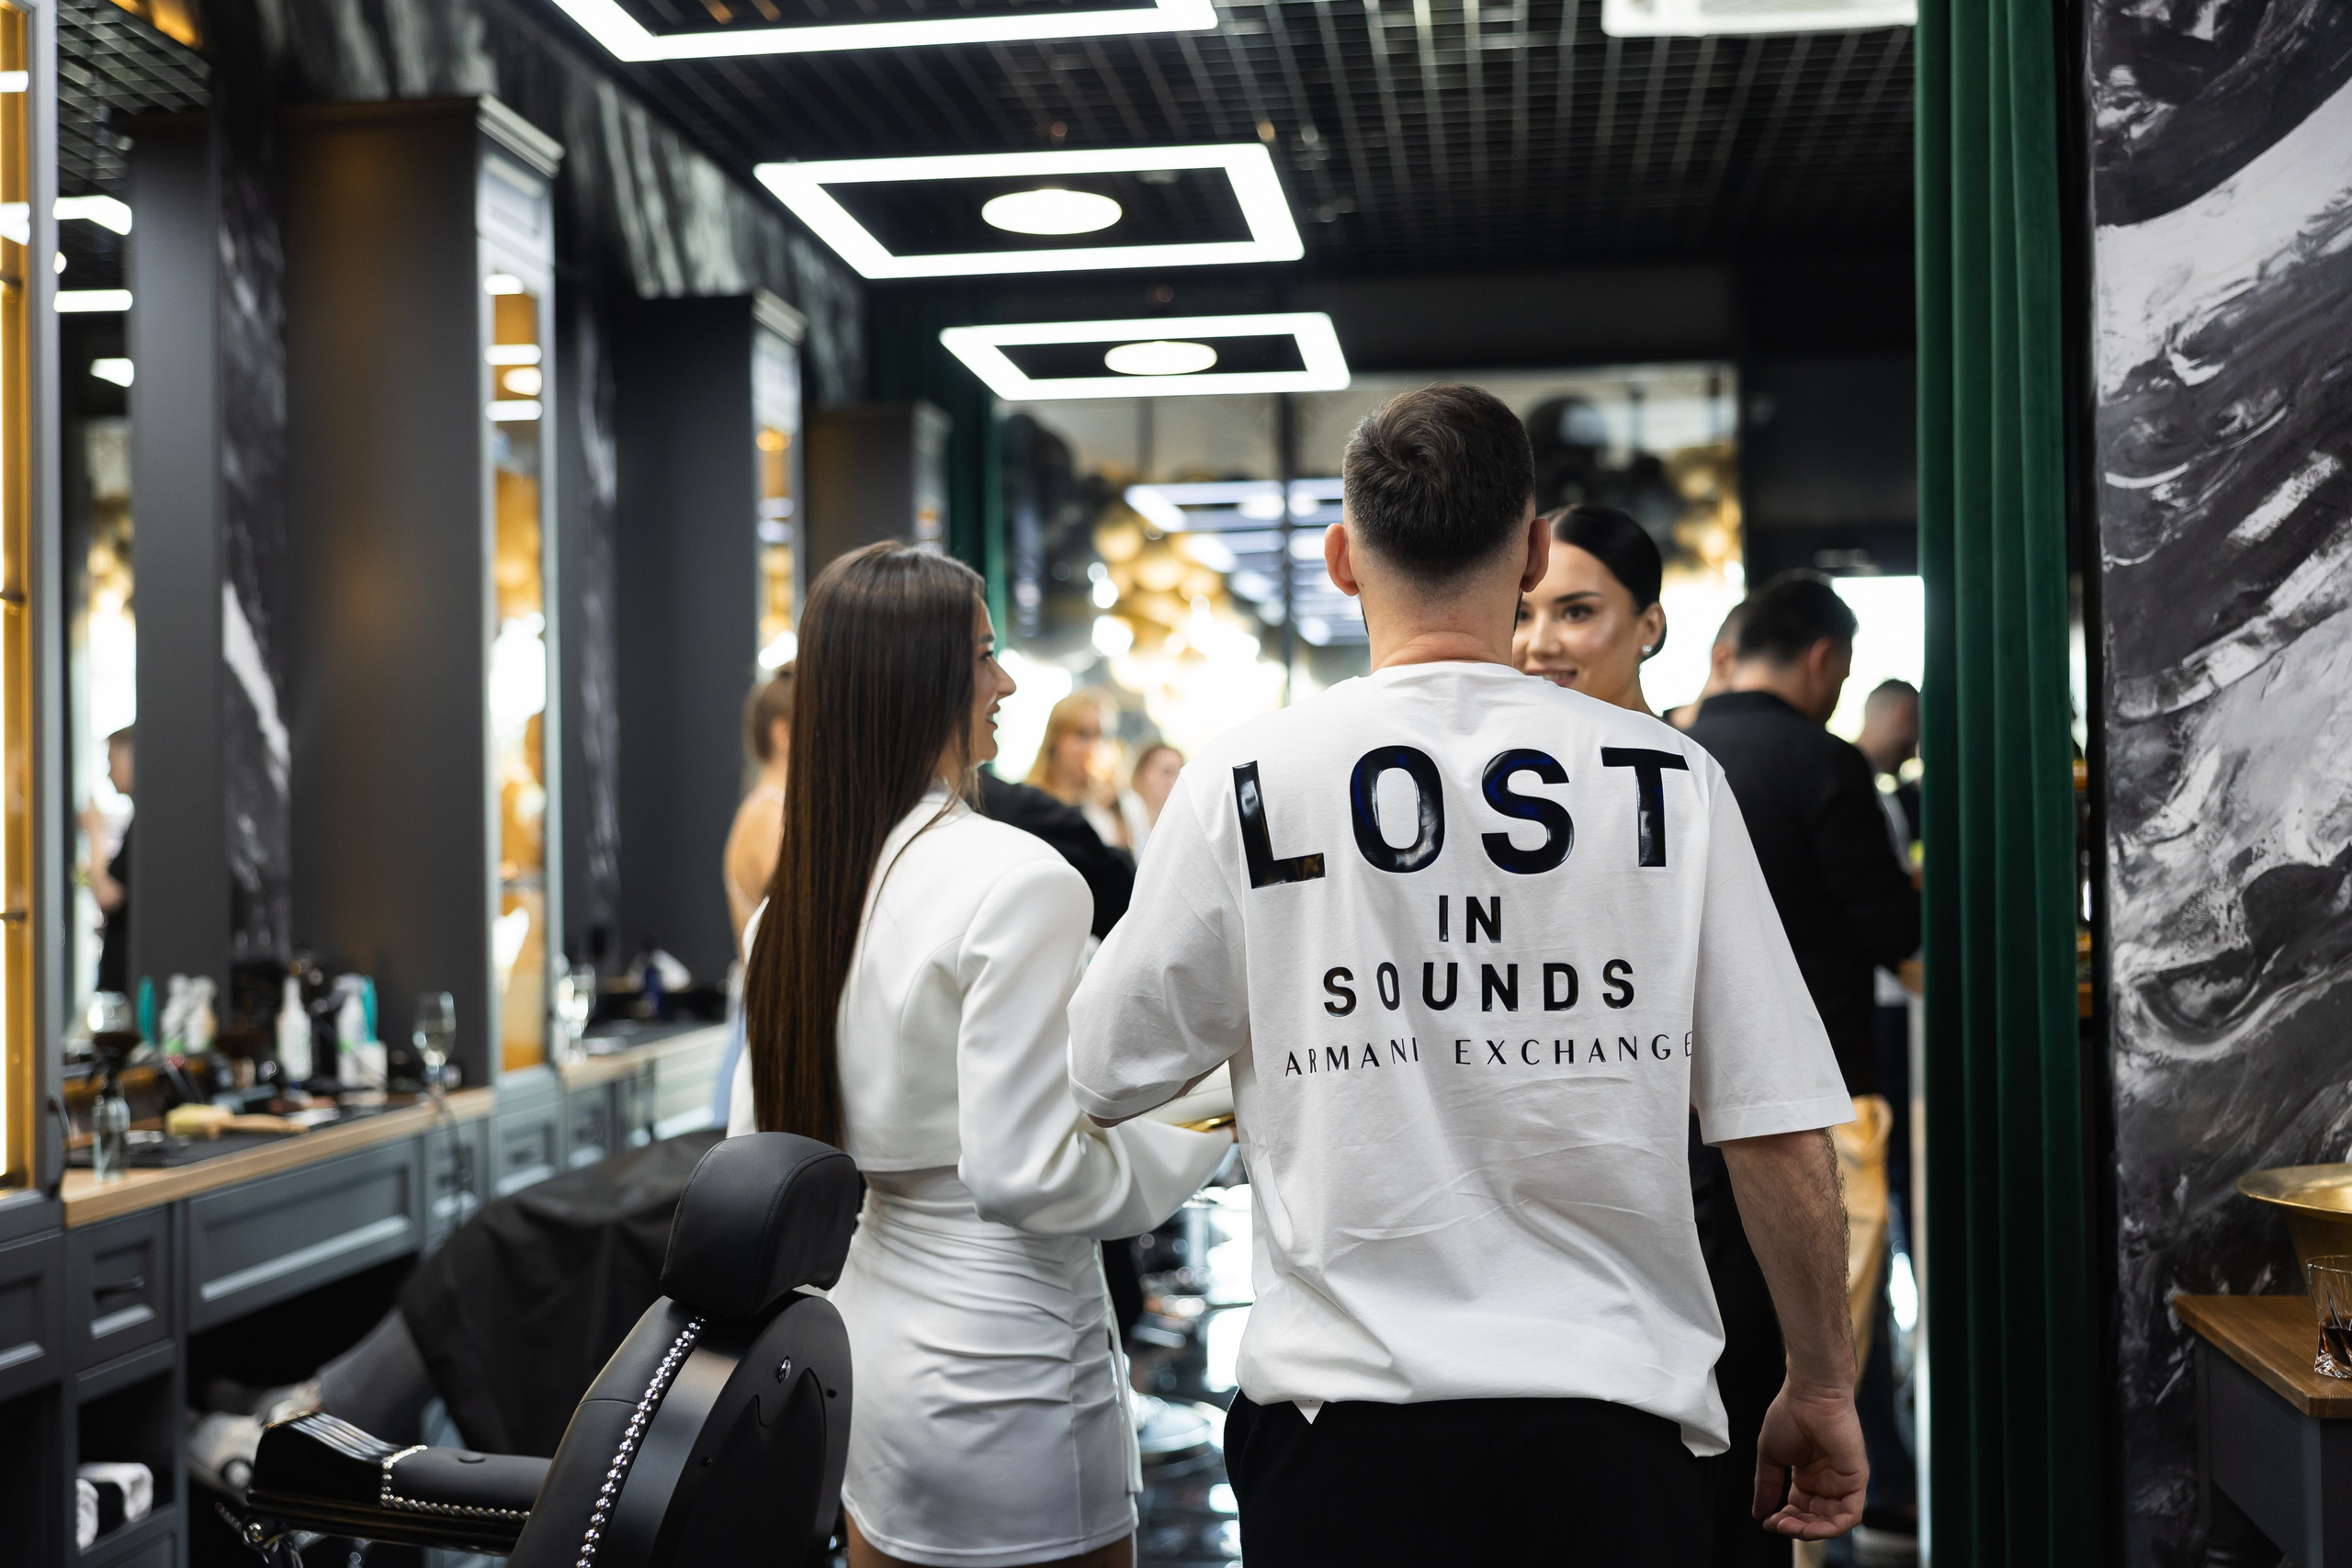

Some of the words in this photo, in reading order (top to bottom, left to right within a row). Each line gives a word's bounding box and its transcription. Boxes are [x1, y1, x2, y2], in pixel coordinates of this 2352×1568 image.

[1232, 745, 1690, 888] LOST
[1439, 895, 1501, 943] IN
[1324, 959, 1634, 1017] SOUNDS
[1284, 1036, 1419, 1077] ARMANI
[1455, 1031, 1692, 1066] EXCHANGE
